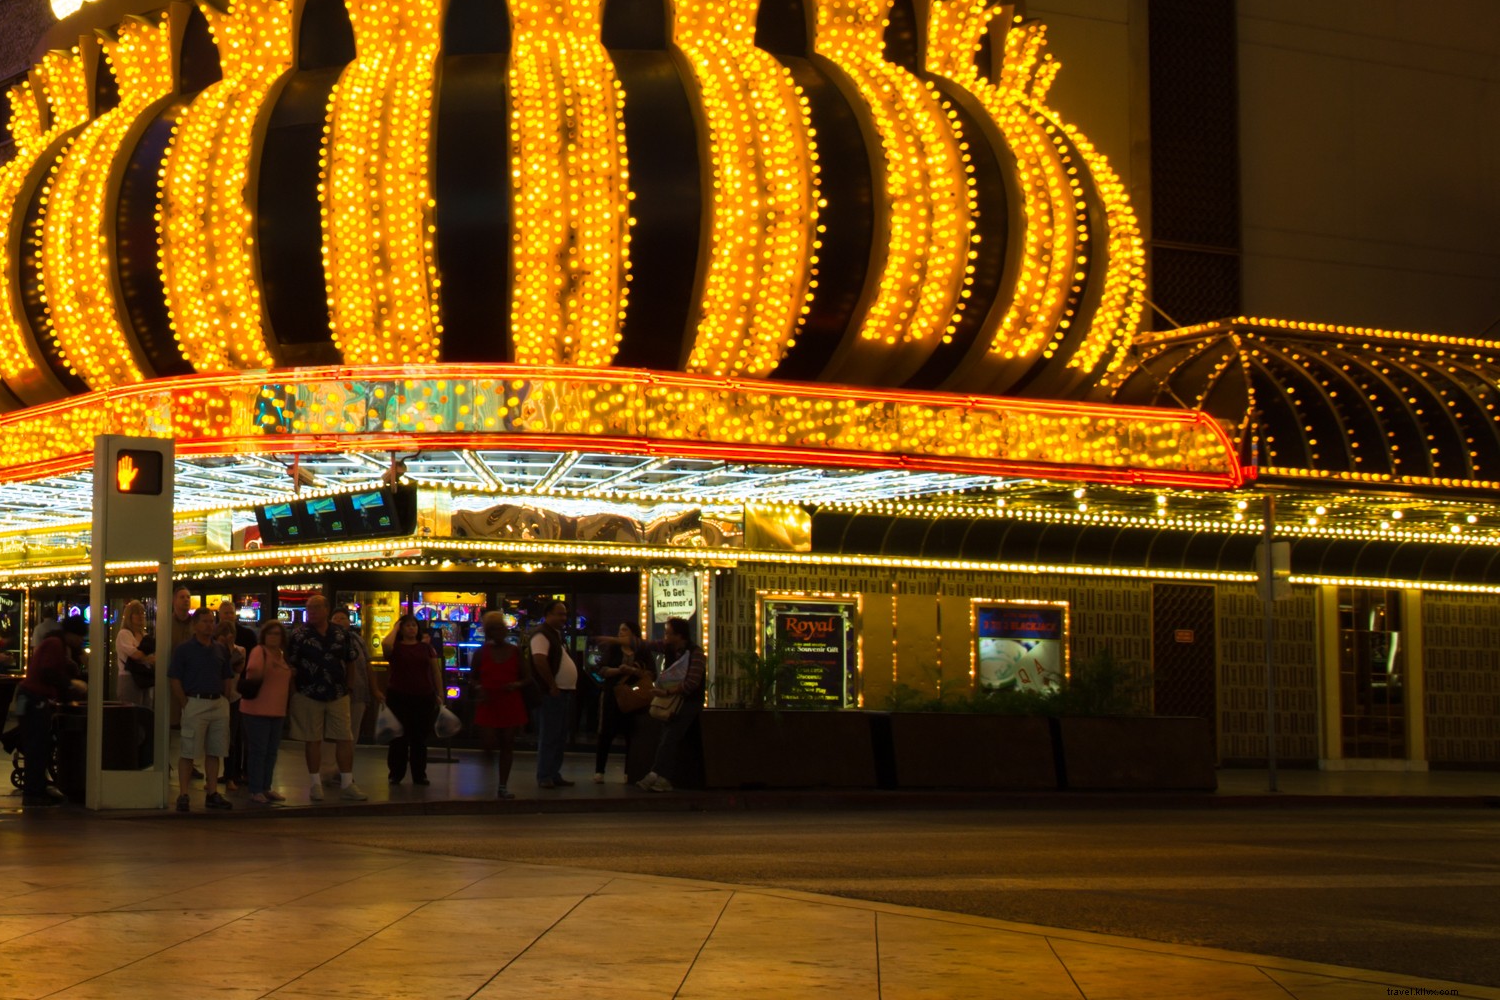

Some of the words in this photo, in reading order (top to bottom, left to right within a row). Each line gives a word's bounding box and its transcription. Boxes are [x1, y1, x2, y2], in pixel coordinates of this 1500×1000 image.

[662, 588, 671, 597] To
[672, 588, 686, 597] Get
[656, 598, 693, 608] Hammer'd
[785, 616, 836, 641] Royal
